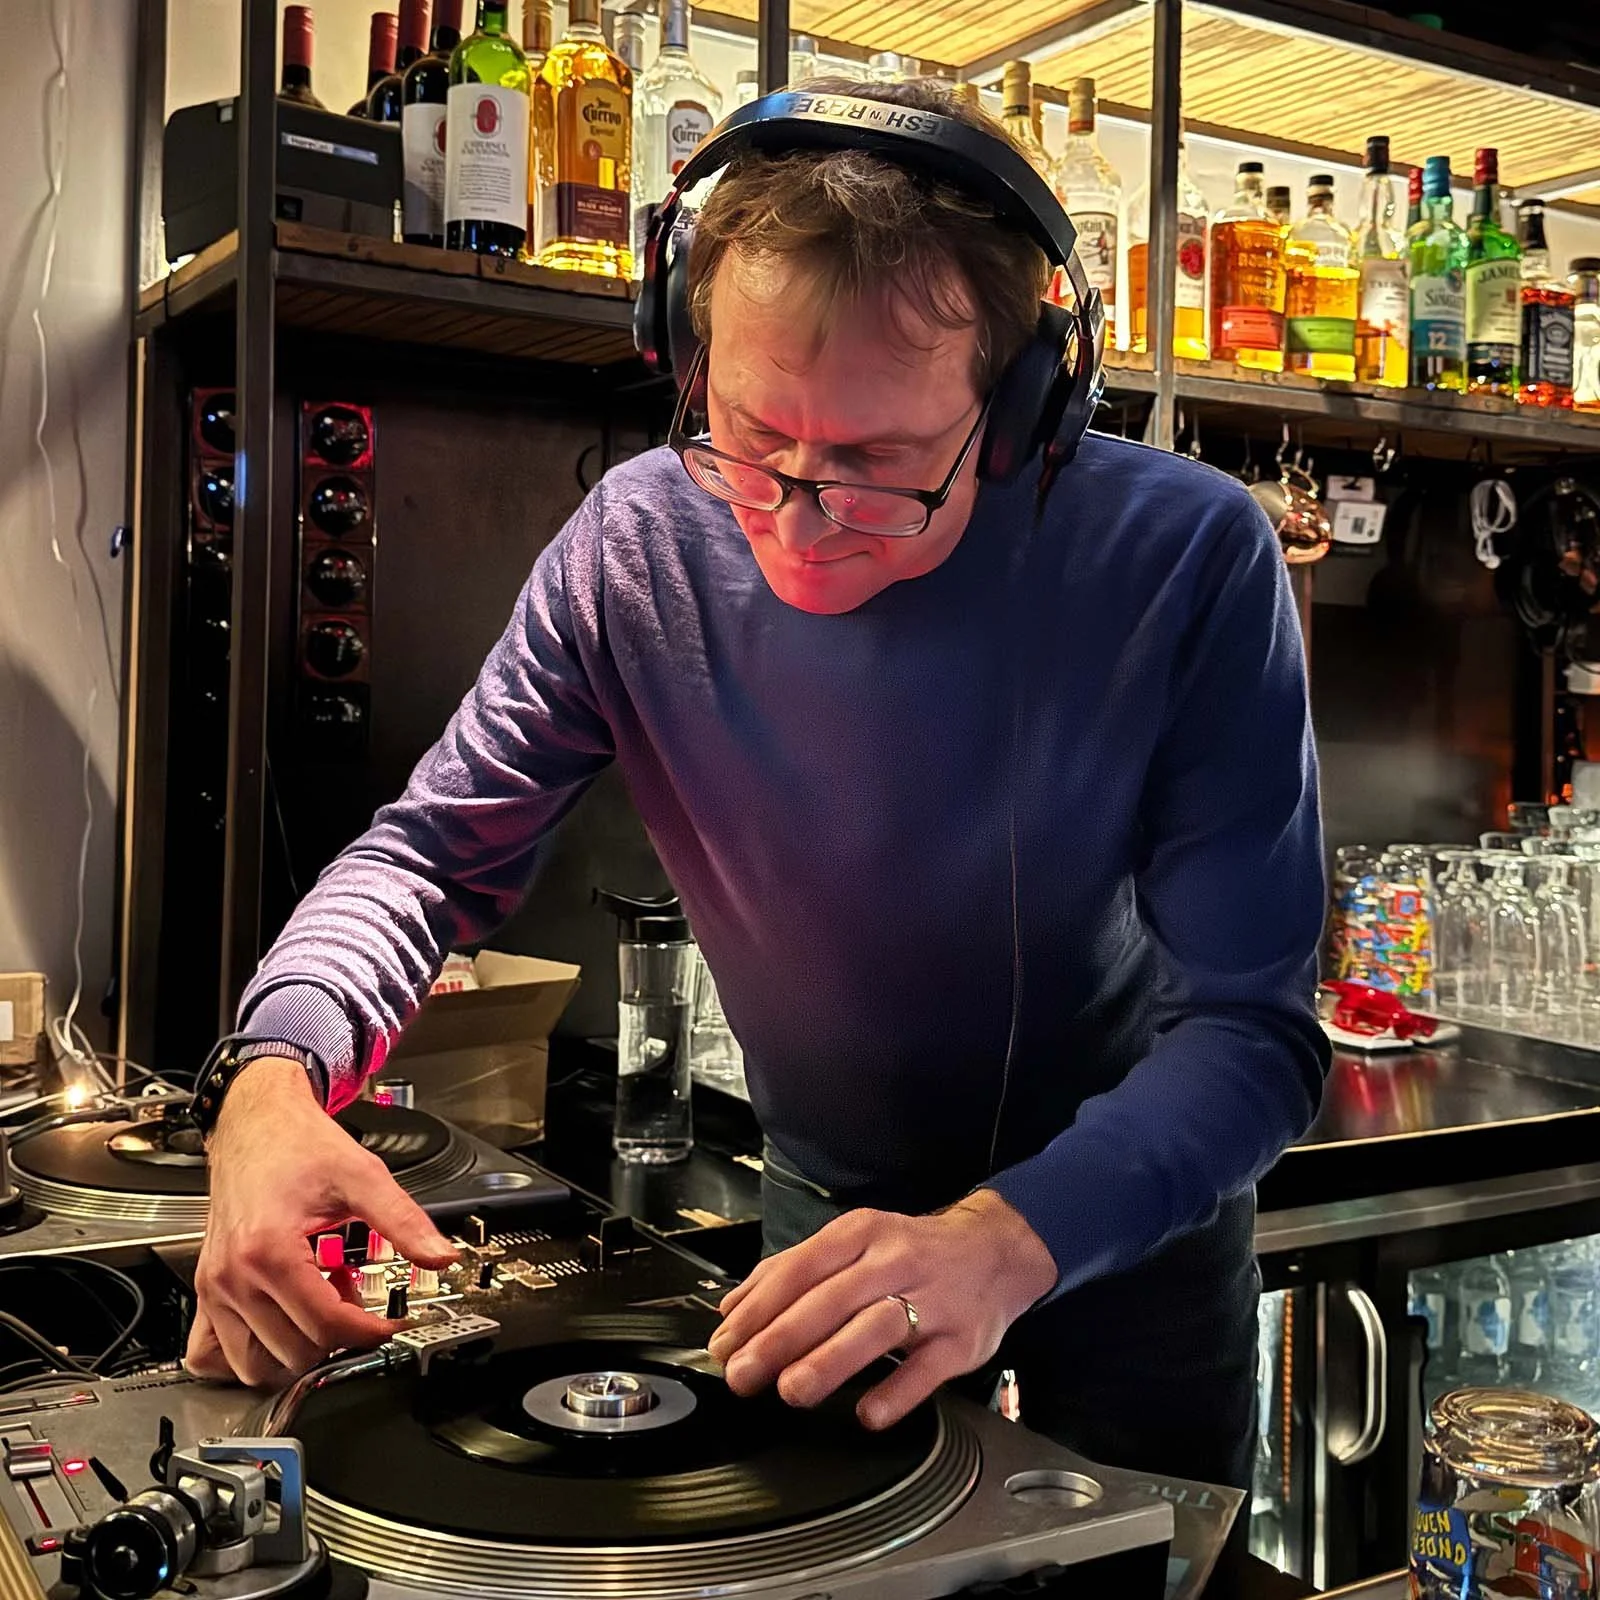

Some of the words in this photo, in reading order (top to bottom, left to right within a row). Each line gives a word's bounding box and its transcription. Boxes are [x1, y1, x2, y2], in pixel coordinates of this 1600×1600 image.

[582, 103, 622, 126] Cuervo
[886, 111, 938, 136] ESH
[1428, 332, 1447, 350] 12
